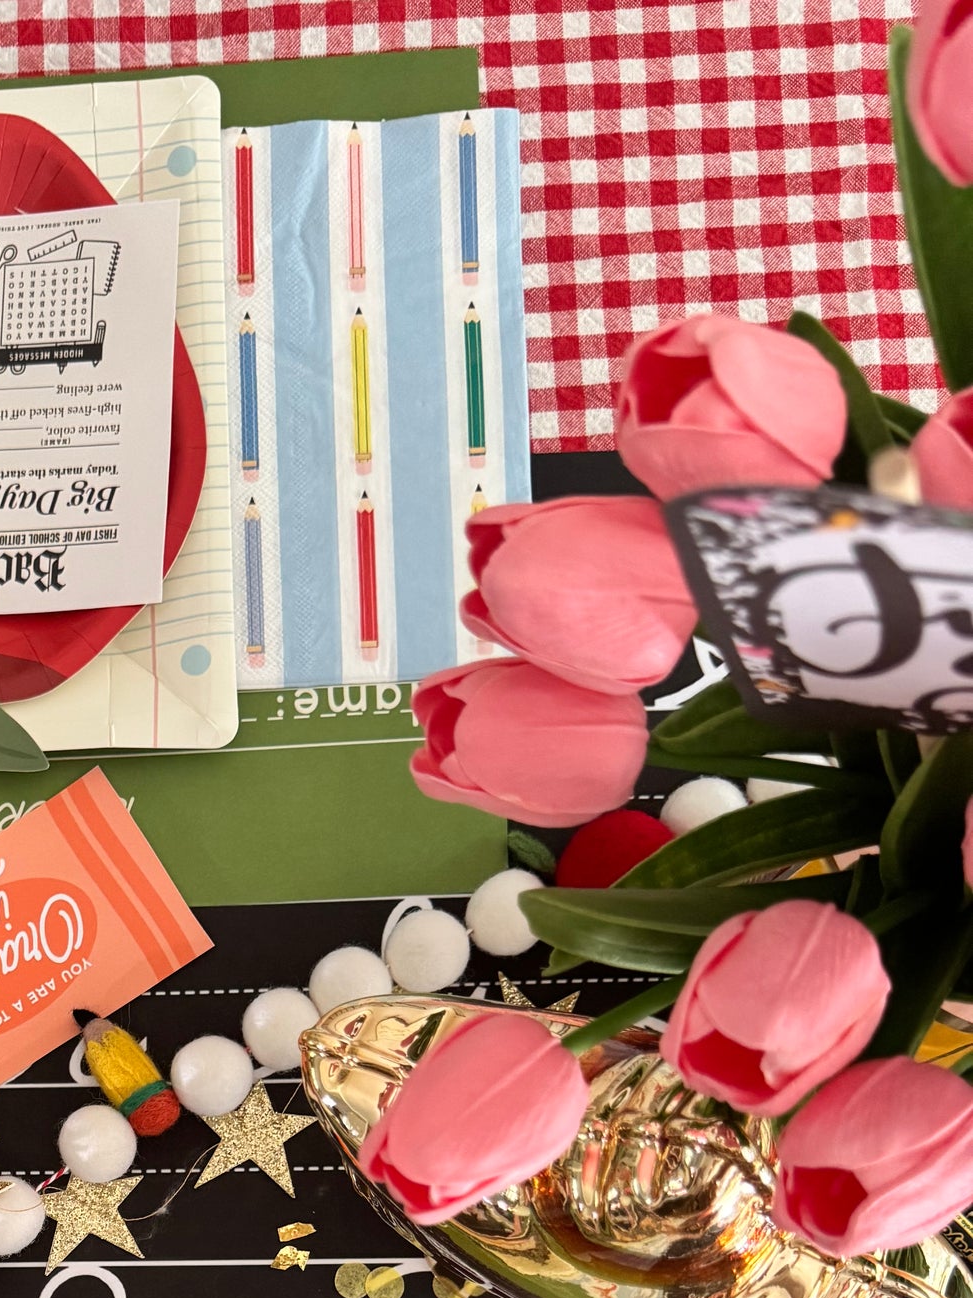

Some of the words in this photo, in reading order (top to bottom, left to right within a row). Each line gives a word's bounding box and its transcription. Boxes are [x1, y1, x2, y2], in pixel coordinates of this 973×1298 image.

[8, 351, 49, 361] MESSAGES
[53, 349, 83, 358] HIDDEN
[55, 384, 93, 396] feeling
[96, 384, 122, 393] were
[9, 409, 25, 420] off
[28, 407, 64, 418] kicked
[66, 402, 121, 416] high-fives
[45, 426, 75, 437] color,
[77, 424, 120, 436] favorite
[0, 470, 25, 480] start
[28, 468, 45, 478] the
[48, 467, 82, 478] marks
[85, 465, 117, 476] Today
[66, 480, 119, 514] Big
[27, 532, 59, 544] SCHOOL
[61, 532, 72, 542] OF
[74, 530, 91, 542] DAY
[93, 528, 116, 540] FIRST
[60, 957, 93, 984] YOU
[28, 979, 57, 1006] ARE
[12, 999, 25, 1014] A
